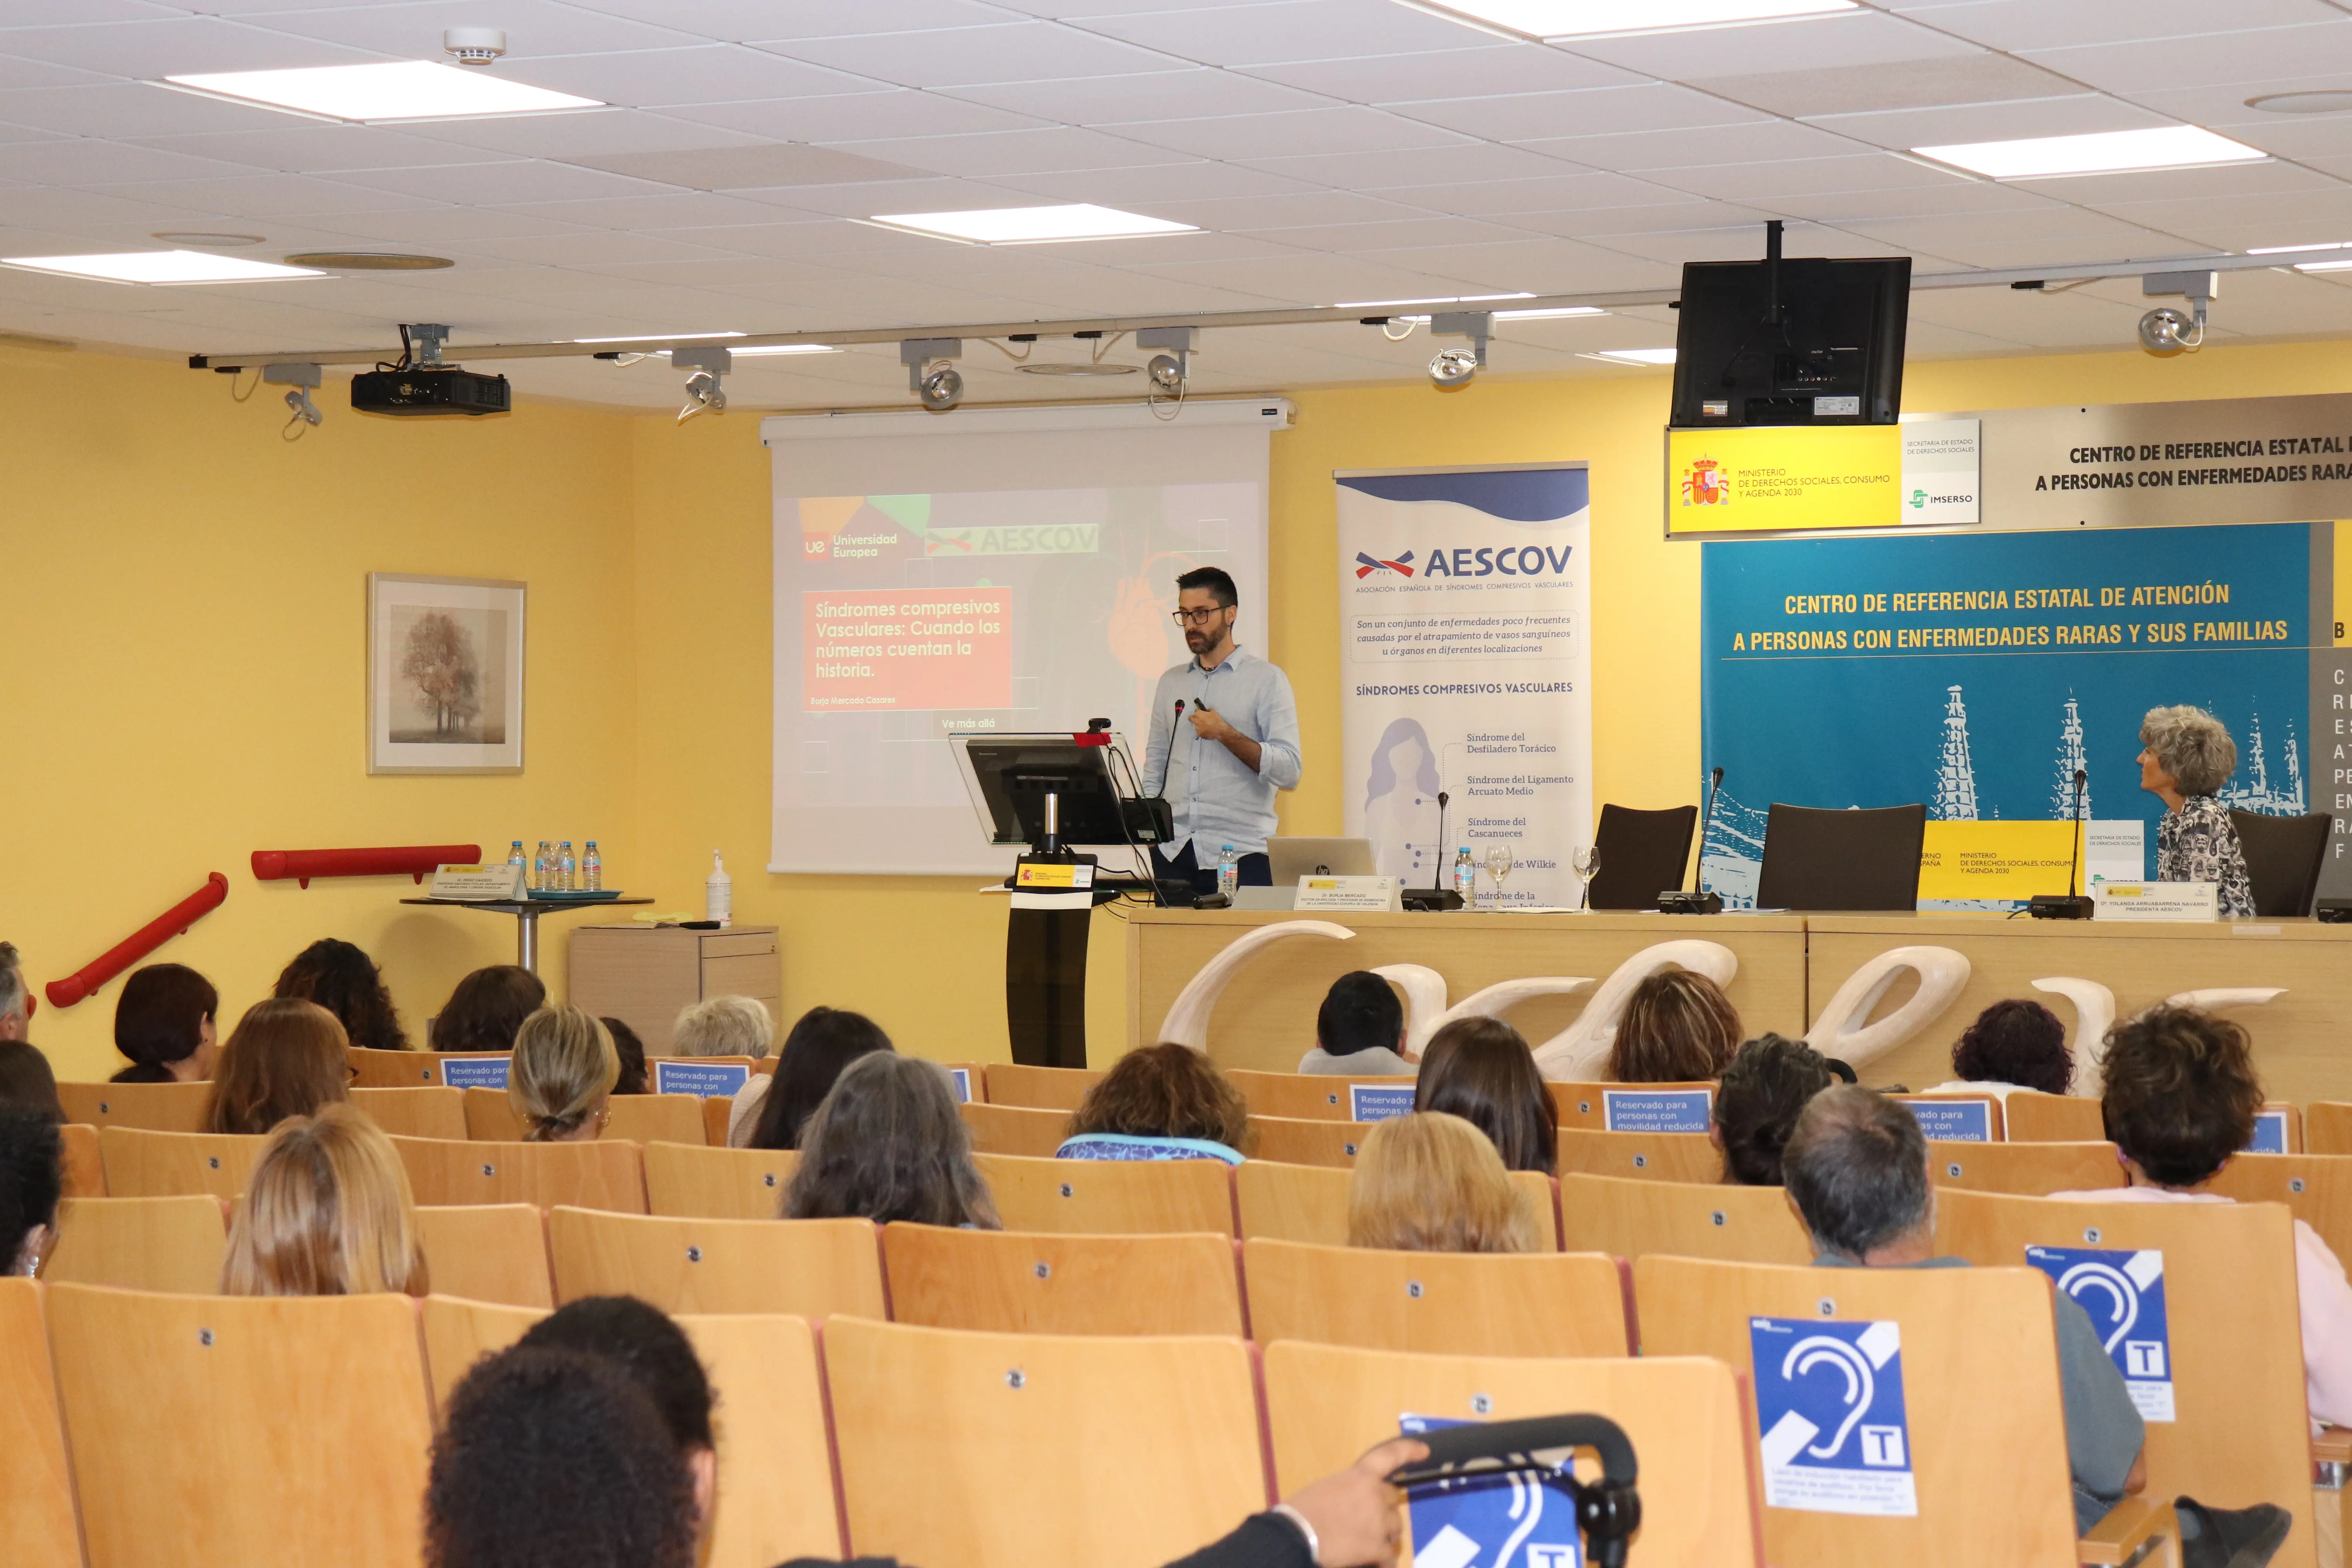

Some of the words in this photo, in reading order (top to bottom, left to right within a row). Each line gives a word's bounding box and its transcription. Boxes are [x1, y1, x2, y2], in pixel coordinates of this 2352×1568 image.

[2069, 445, 2135, 464] CENTRO
[2140, 444, 2160, 461] DE
[2165, 440, 2264, 459] REFERENCIA
[2268, 437, 2343, 456] ESTATAL
[1752, 477, 1797, 486] DERECHOS
[1800, 477, 1841, 486] SOCIALES,
[1843, 475, 1890, 484] CONSUMO
[2035, 476, 2047, 491] A
[2052, 472, 2134, 490] PERSONAS
[2138, 470, 2173, 487] CON
[2177, 465, 2307, 486] ENFERMEDADES
[1931, 495, 1972, 503] IMSERSO
[806, 539, 825, 554] ue
[833, 532, 897, 546] Universidad
[982, 526, 1096, 553] AESCOV
[833, 546, 878, 559] Europea
[1424, 546, 1572, 577] AESCOV
[1785, 594, 1857, 614] CENTRO
[1863, 593, 1886, 613] DE
[1893, 591, 2008, 611] REFERENCIA
[2014, 588, 2094, 608] ESTATAL
[2100, 587, 2124, 606] DE
[2131, 580, 2229, 605] ATENCIÓN
[816, 601, 895, 618] Síndromes
[900, 598, 1000, 619] compresivos
[816, 621, 906, 638] Vasculares:
[910, 619, 974, 637] Cuando
[978, 619, 1000, 635] los
[1357, 620, 1372, 628] Son
[1388, 619, 1426, 630] conjunto
[1428, 619, 1438, 627] de
[1441, 617, 1499, 628] enfermedades
[1503, 619, 1523, 628] poco
[1525, 616, 1570, 627] frecuentes
[1423, 632, 1481, 642] atrapamiento
[1522, 630, 1570, 640] sanguíneos
[1733, 633, 1745, 650] A
[1751, 630, 1847, 650] PERSONAS
[1853, 629, 1891, 648] CON
[1897, 626, 2049, 648] ENFERMEDADES
[2056, 625, 2122, 644] RARAS
[2129, 624, 2140, 642] Y
[2147, 622, 2186, 642] SUS
[2194, 620, 2288, 641] FAMILIAS
[2334, 622, 2345, 638] B
[816, 642, 882, 658] números
[888, 641, 952, 656] cuentan
[957, 641, 971, 655] la
[1390, 646, 1424, 657] órganos
[1439, 644, 1482, 655] diferentes
[1484, 644, 1543, 653] localizaciones
[816, 662, 875, 678] historia.
[1356, 683, 1419, 696] SÍNDROMES
[1423, 684, 1501, 694] COMPRESIVOS
[1506, 683, 1572, 693] VASCULARES
[811, 697, 829, 706] Borja
[942, 720, 954, 728] Ve
[957, 719, 975, 728] más
[978, 718, 995, 728] allá
[1467, 733, 1509, 742] Síndrome
[1467, 745, 1517, 753] Desfiladero
[1519, 744, 1555, 753] Torácico
[1528, 775, 1573, 785] Ligamento
[1506, 787, 1533, 795] Medio
[666, 1071, 706, 1080] Reservado
[1361, 1096, 1406, 1105] Reservado
[1616, 1101, 1663, 1109] Reservado
[1667, 1102, 1687, 1110] para
[1942, 1111, 1963, 1120] para
[2133, 1345, 2156, 1372] T
[1869, 1430, 1894, 1461] T
